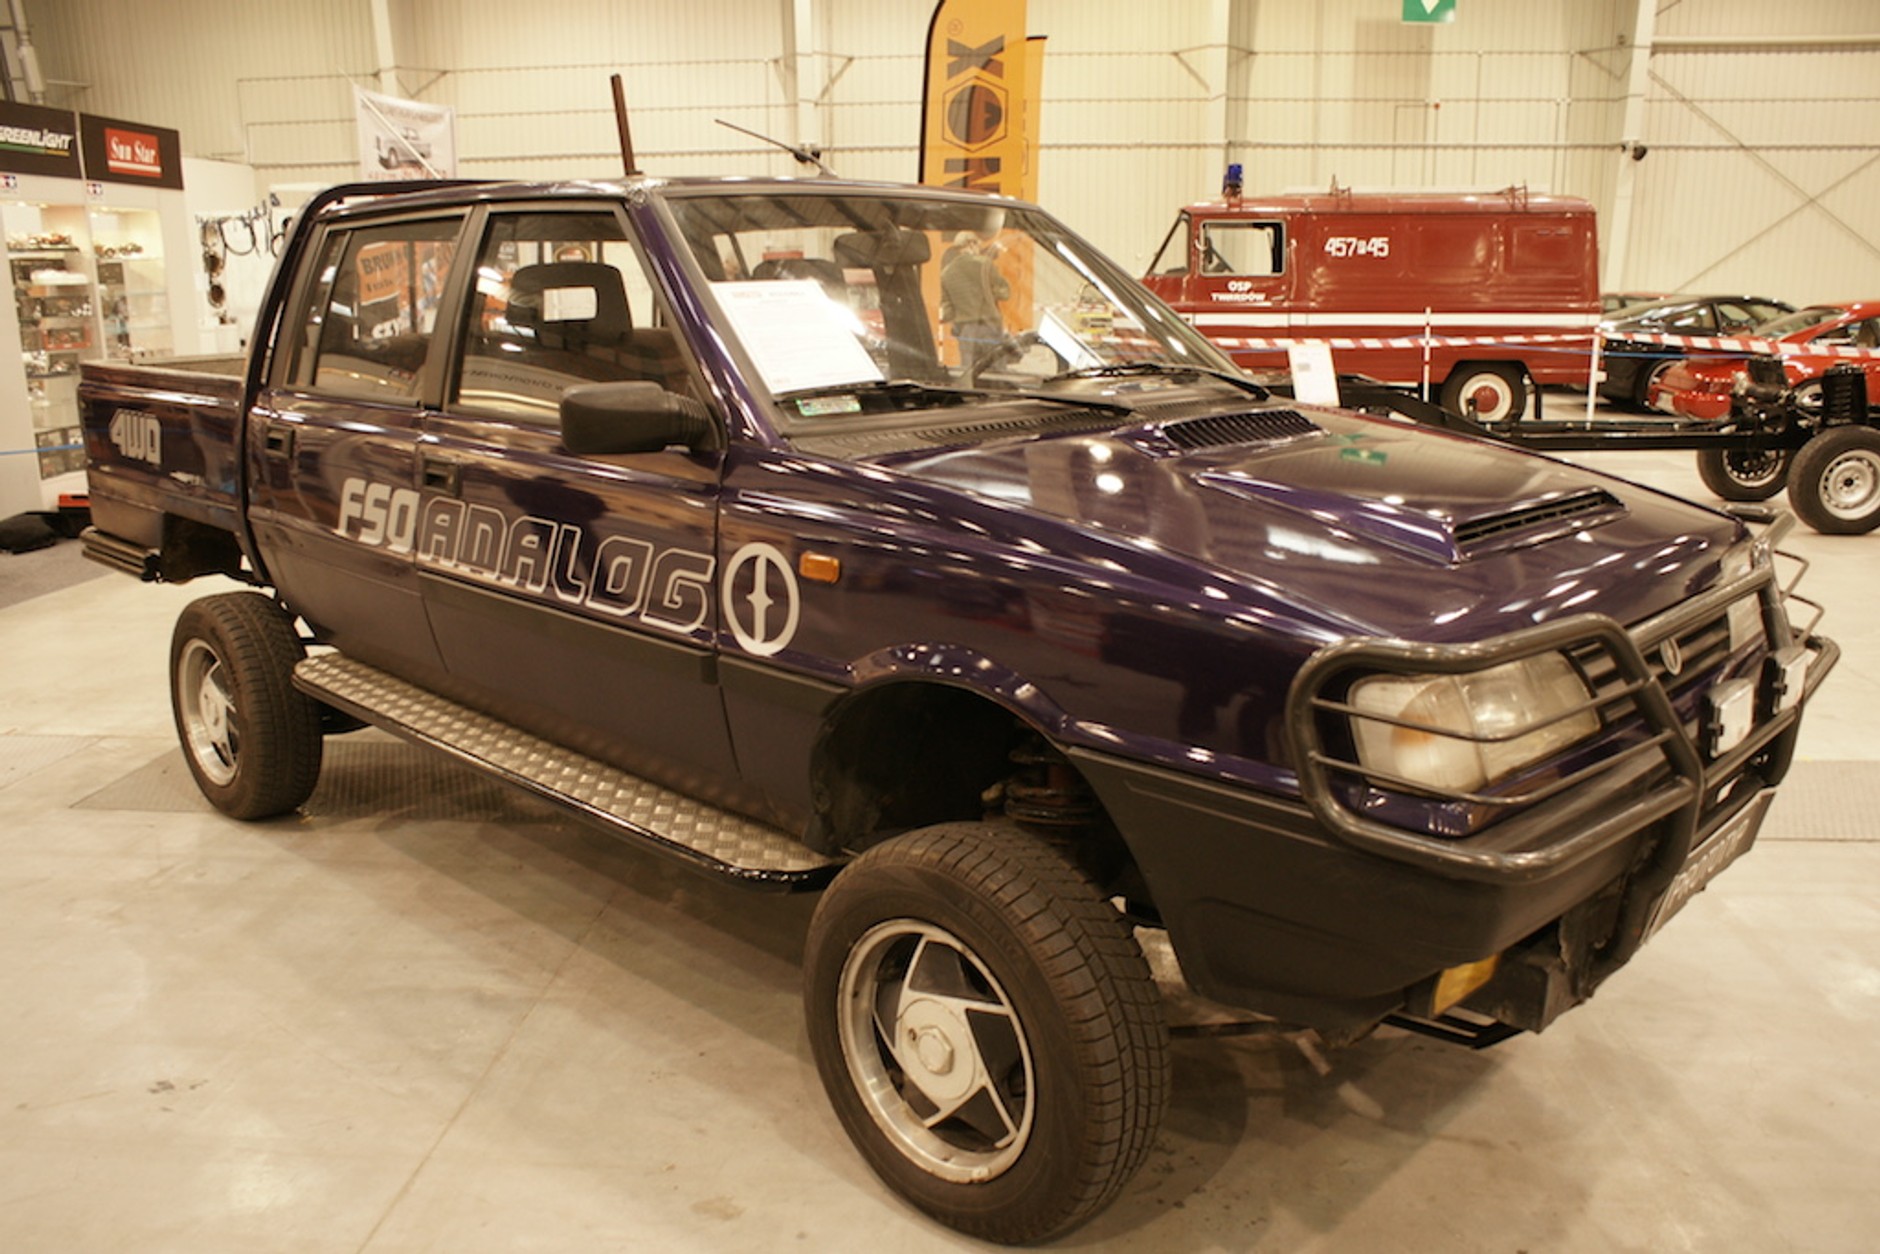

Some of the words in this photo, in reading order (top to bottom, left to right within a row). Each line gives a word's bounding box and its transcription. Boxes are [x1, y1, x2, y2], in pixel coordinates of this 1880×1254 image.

[111, 136, 131, 161] Sun
[134, 140, 156, 164] Star
[1227, 280, 1252, 292] OSP
[336, 477, 421, 554] FSO
[416, 496, 716, 634] ANALOG
